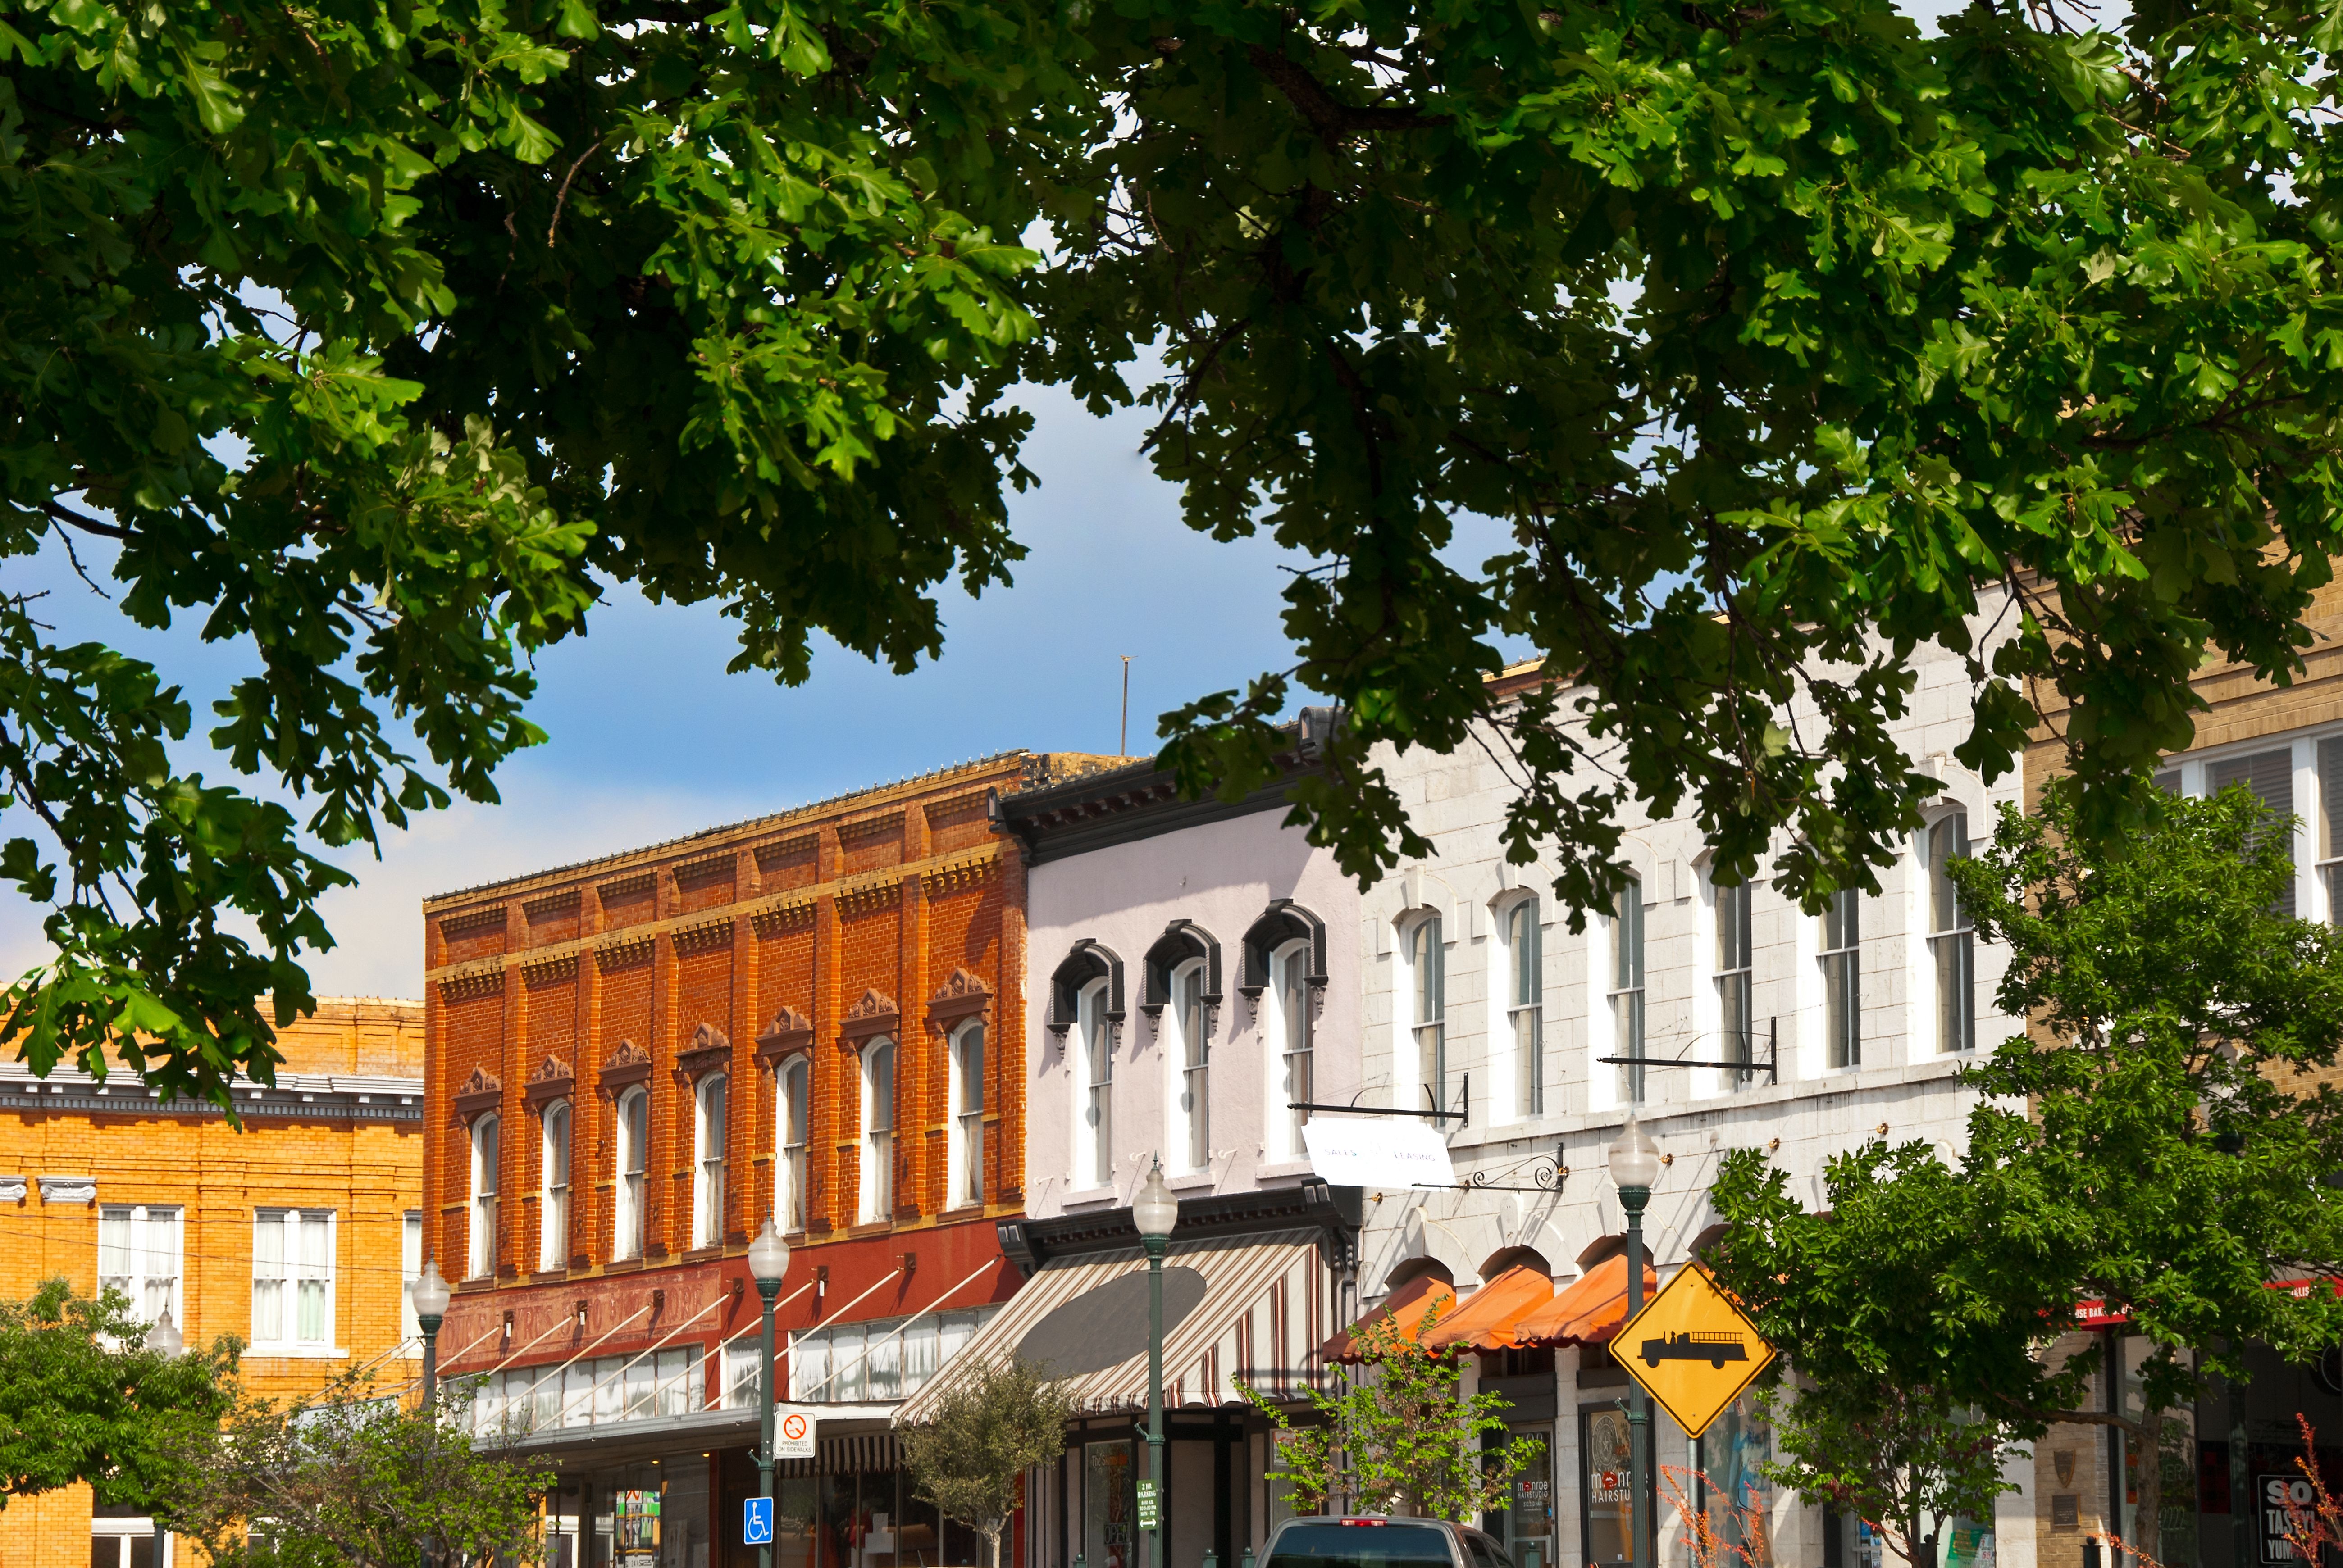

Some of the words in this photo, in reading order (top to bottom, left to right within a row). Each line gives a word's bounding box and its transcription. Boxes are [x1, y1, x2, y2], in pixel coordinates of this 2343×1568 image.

[1394, 1151, 1435, 1161] LEASING
[2089, 1306, 2108, 1318] BAK
[1138, 1490, 1156, 1498] PARKING
[1518, 1491, 1548, 1499] HAIRSTUDIO
[2267, 1480, 2312, 1505] SO
[1105, 1524, 1130, 1543] OPEN
[2268, 1540, 2293, 1559] YUM
